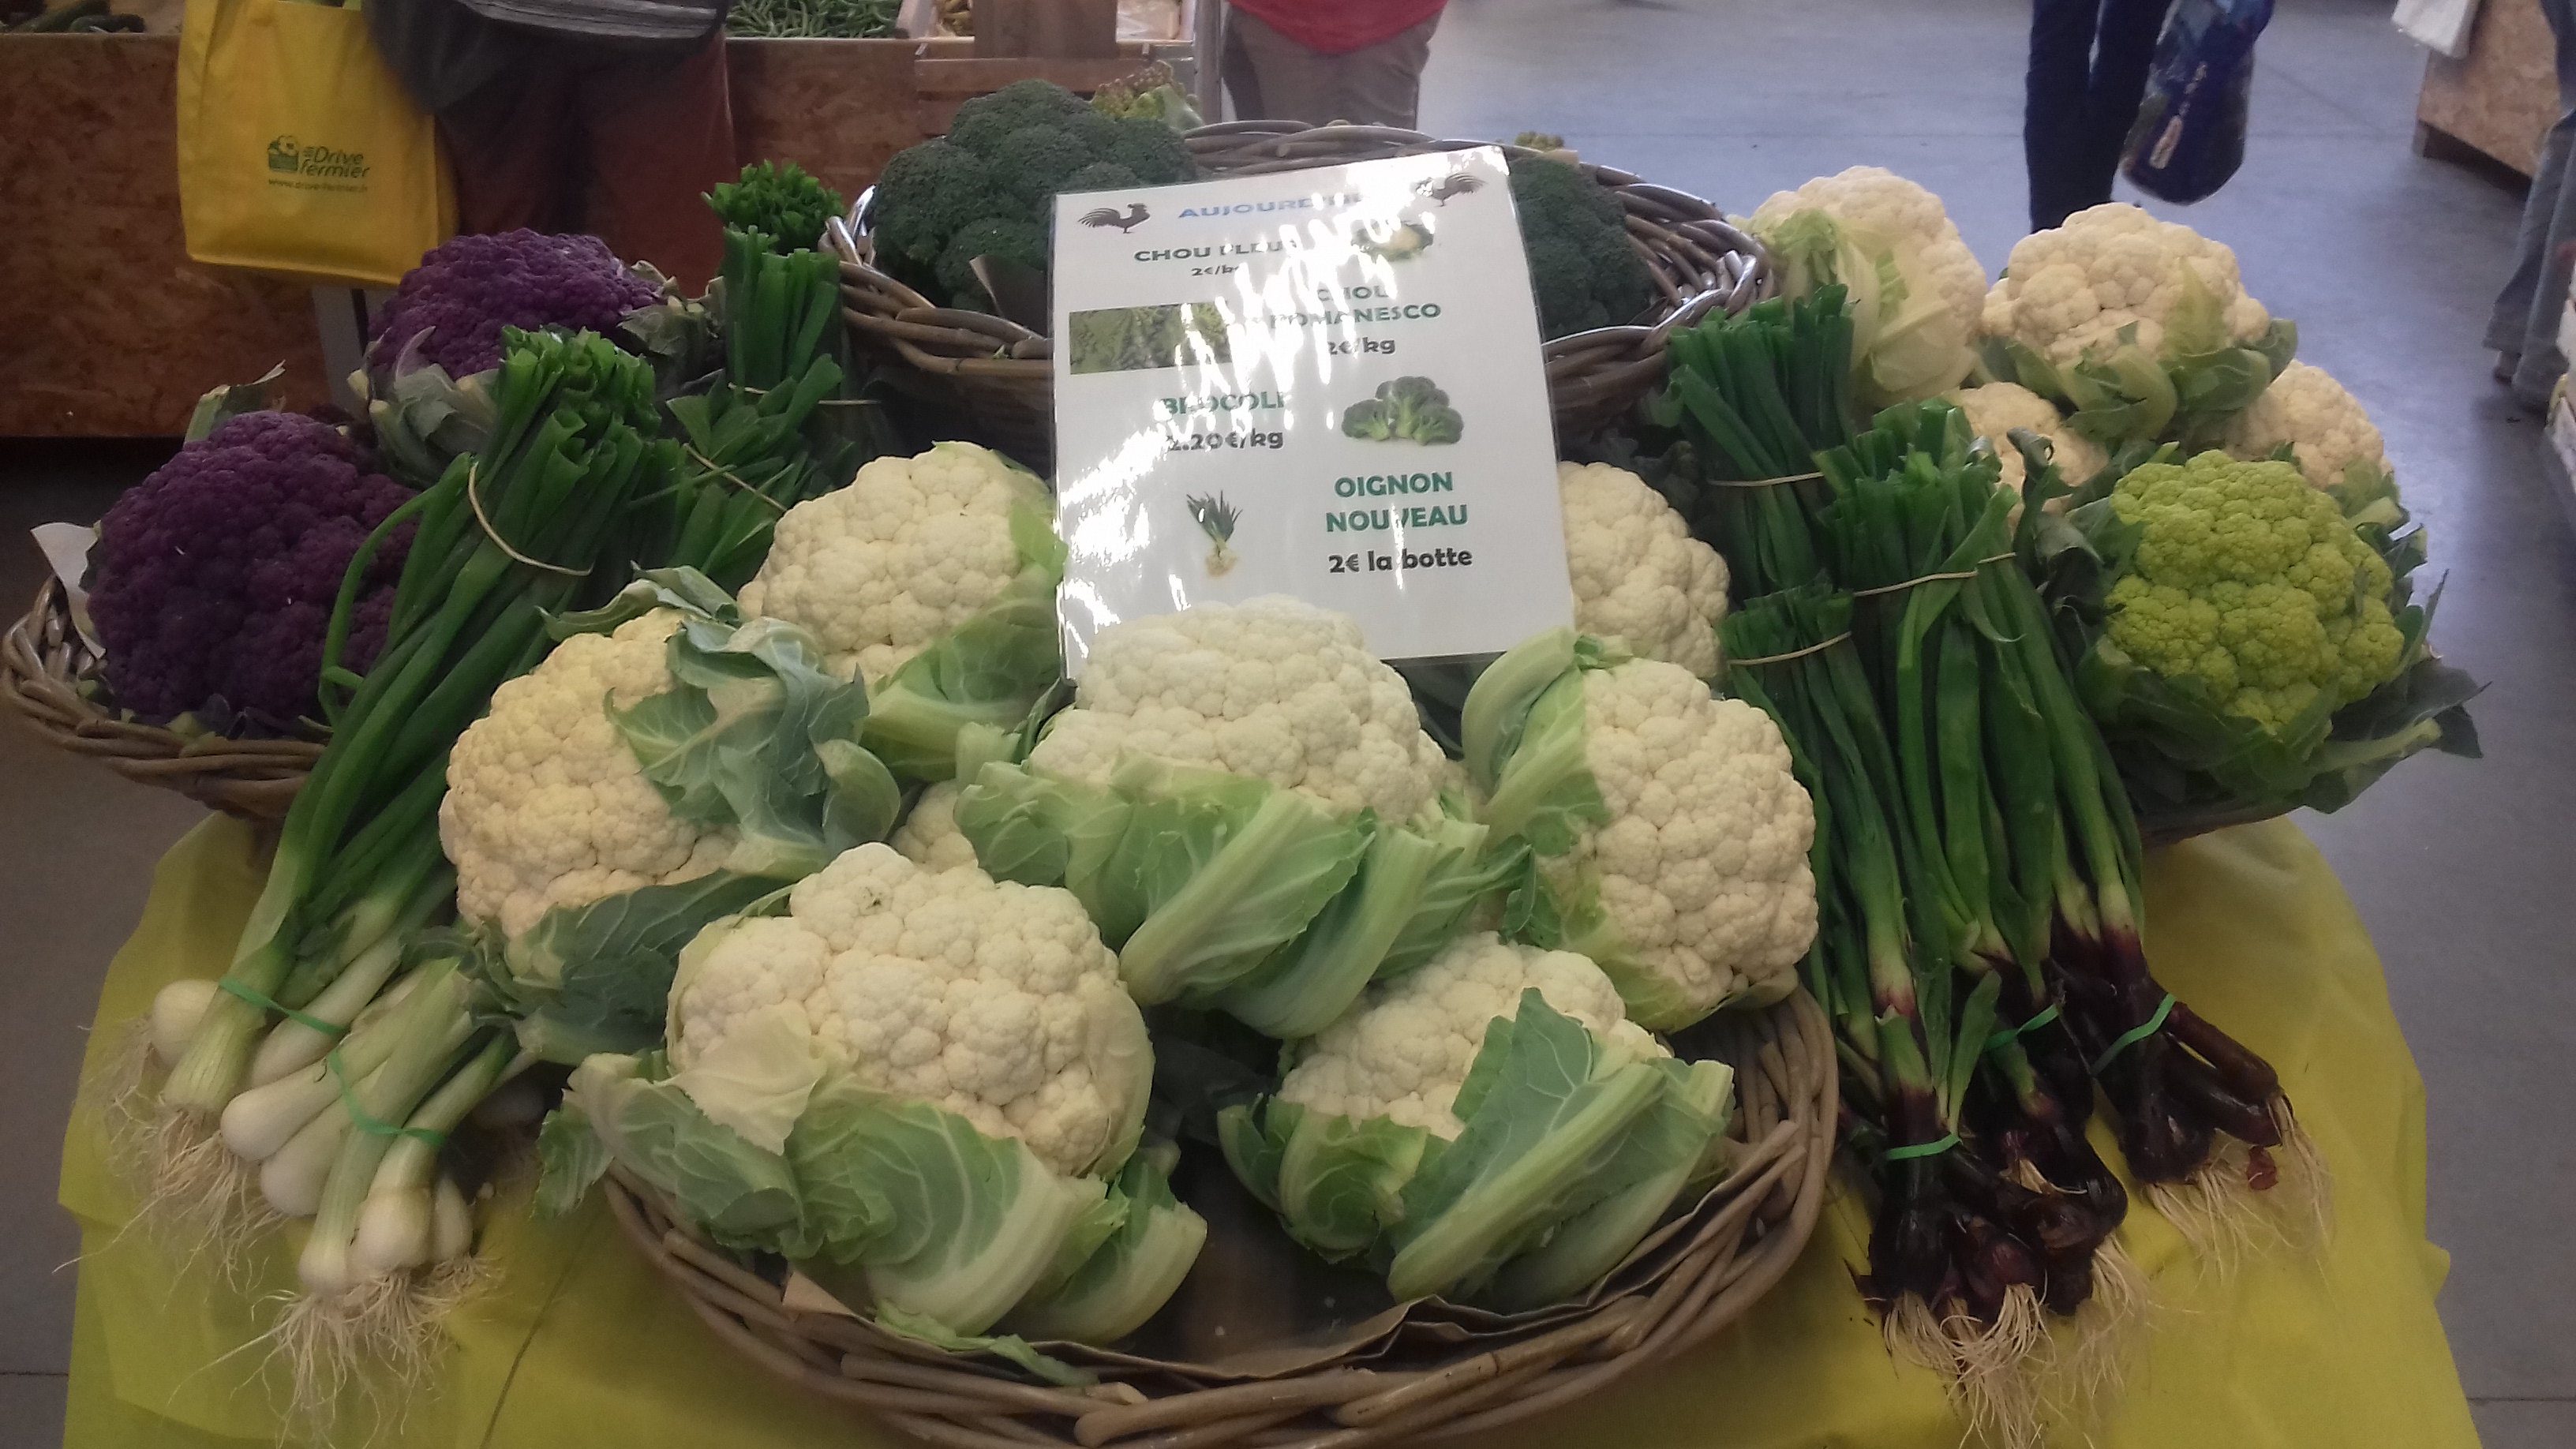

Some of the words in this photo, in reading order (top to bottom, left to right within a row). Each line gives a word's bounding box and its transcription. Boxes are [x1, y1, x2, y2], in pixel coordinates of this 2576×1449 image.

[1134, 246, 1211, 262] CHOU
[1334, 471, 1454, 498] OIGNON
[1328, 553, 1361, 574] 2€
[1368, 550, 1393, 571] la
[1402, 548, 1473, 570] botte
